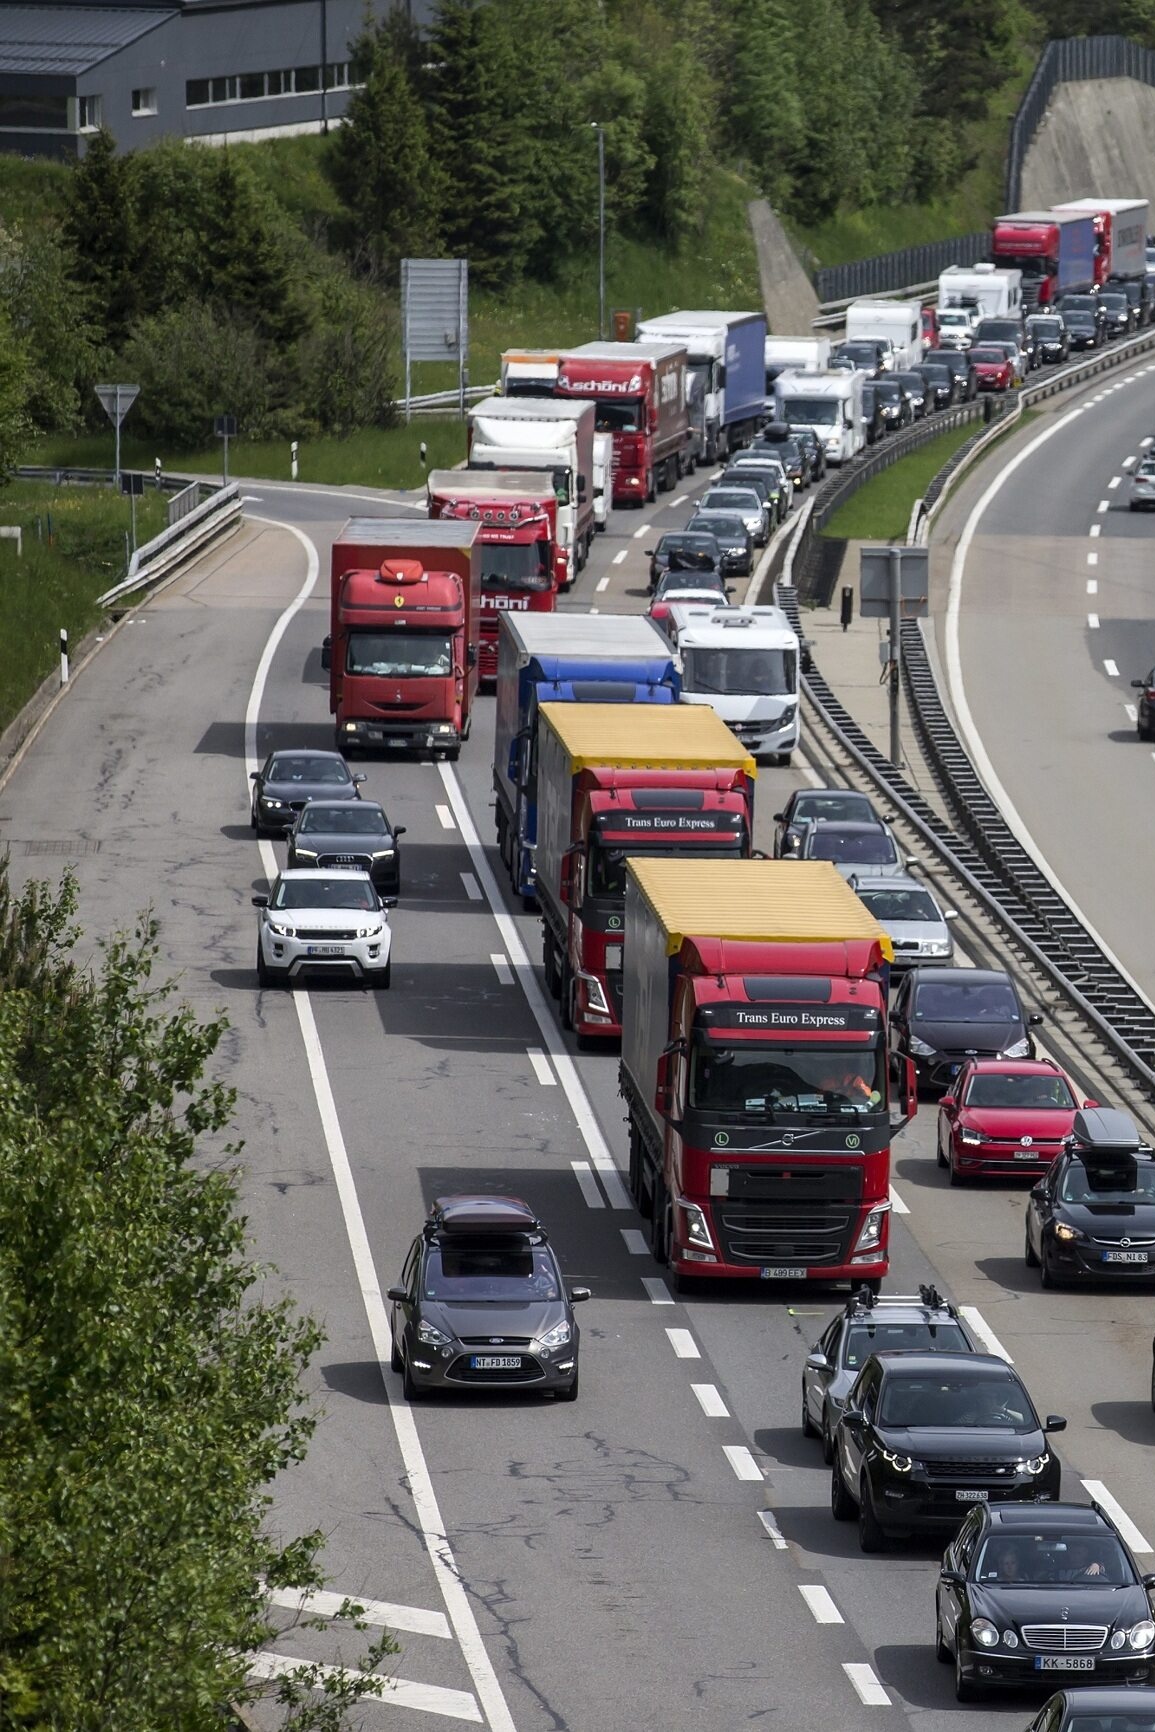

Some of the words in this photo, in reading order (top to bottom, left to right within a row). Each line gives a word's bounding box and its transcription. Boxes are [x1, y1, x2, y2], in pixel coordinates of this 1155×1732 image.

[625, 817, 652, 828] Trans
[653, 817, 677, 828] Euro
[679, 817, 716, 830] Express
[736, 1011, 768, 1025] Trans
[771, 1012, 798, 1025] Euro
[801, 1013, 846, 1028] Express
[476, 1358, 486, 1367] NT
[490, 1358, 501, 1367] FD
[502, 1358, 520, 1367] 1859
[1043, 1658, 1093, 1669] KK-5868
